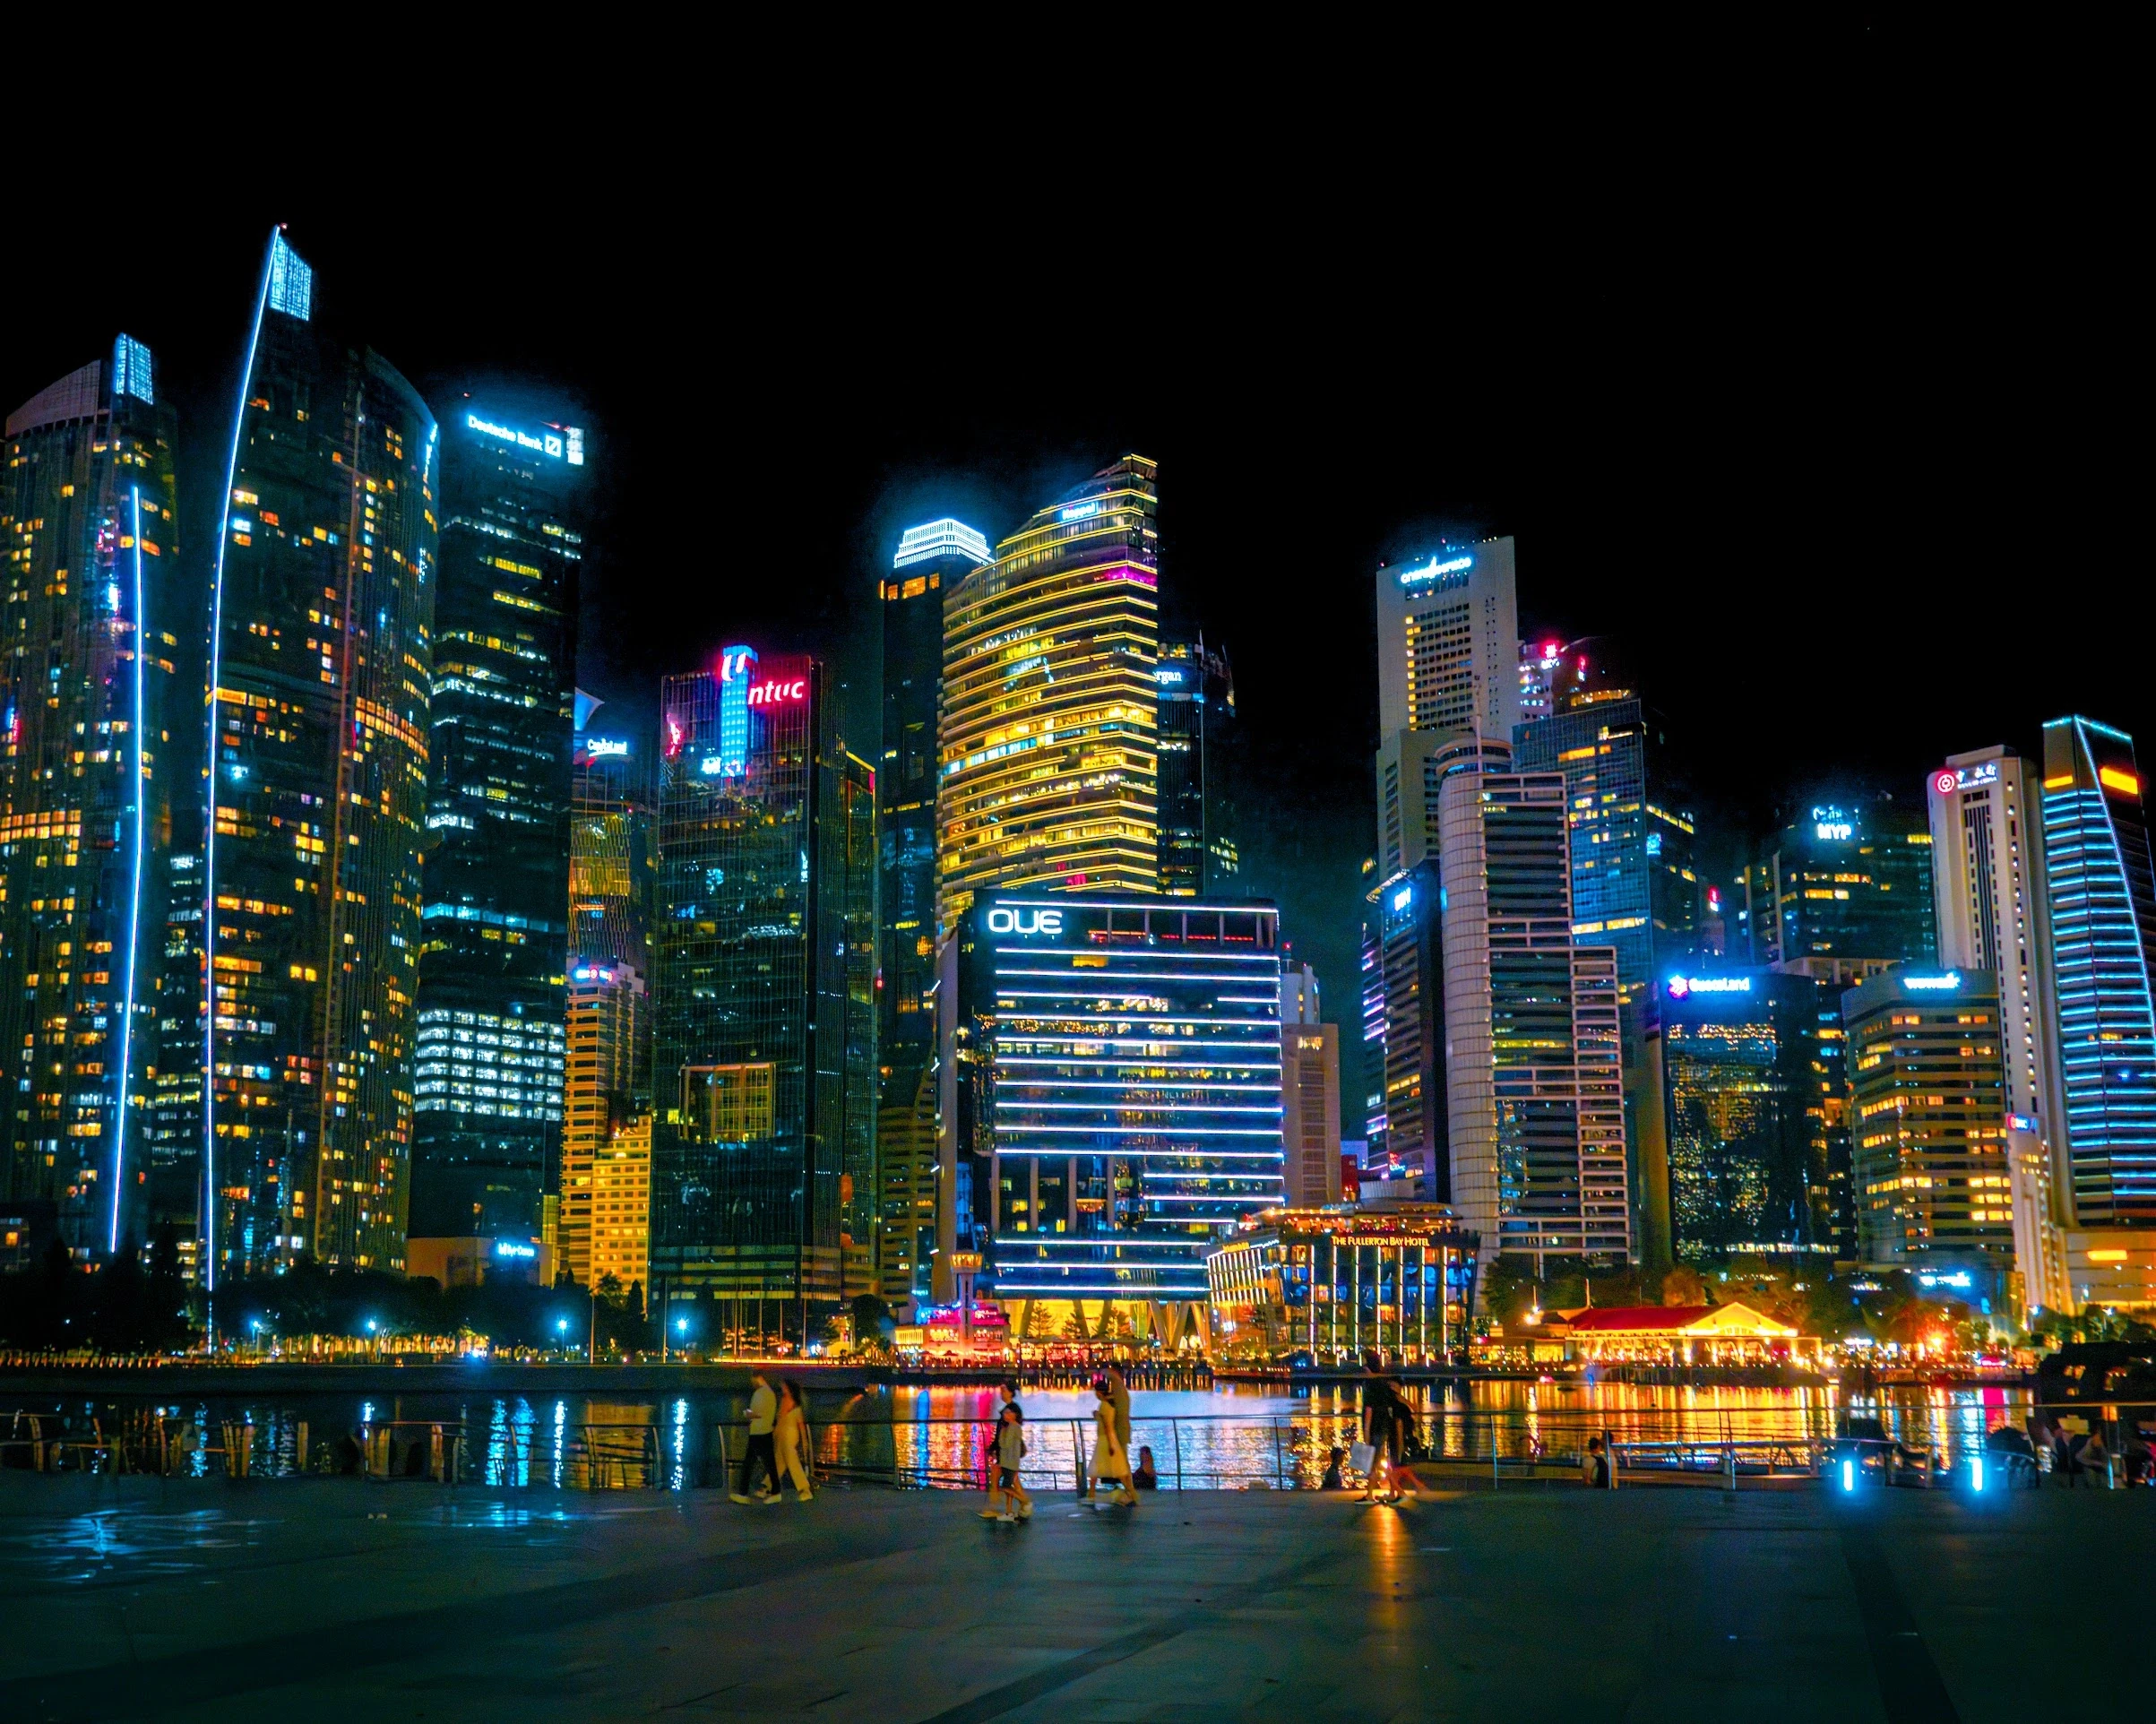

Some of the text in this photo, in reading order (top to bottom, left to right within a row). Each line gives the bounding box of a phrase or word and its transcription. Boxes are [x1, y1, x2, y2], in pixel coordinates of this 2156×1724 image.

[517, 431, 544, 452] Bank
[747, 681, 804, 705] ntuc
[1817, 823, 1852, 840] MYP
[988, 909, 1063, 934] OUE
[1332, 1236, 1430, 1246] THE FULLERTON BAY HOTEL
